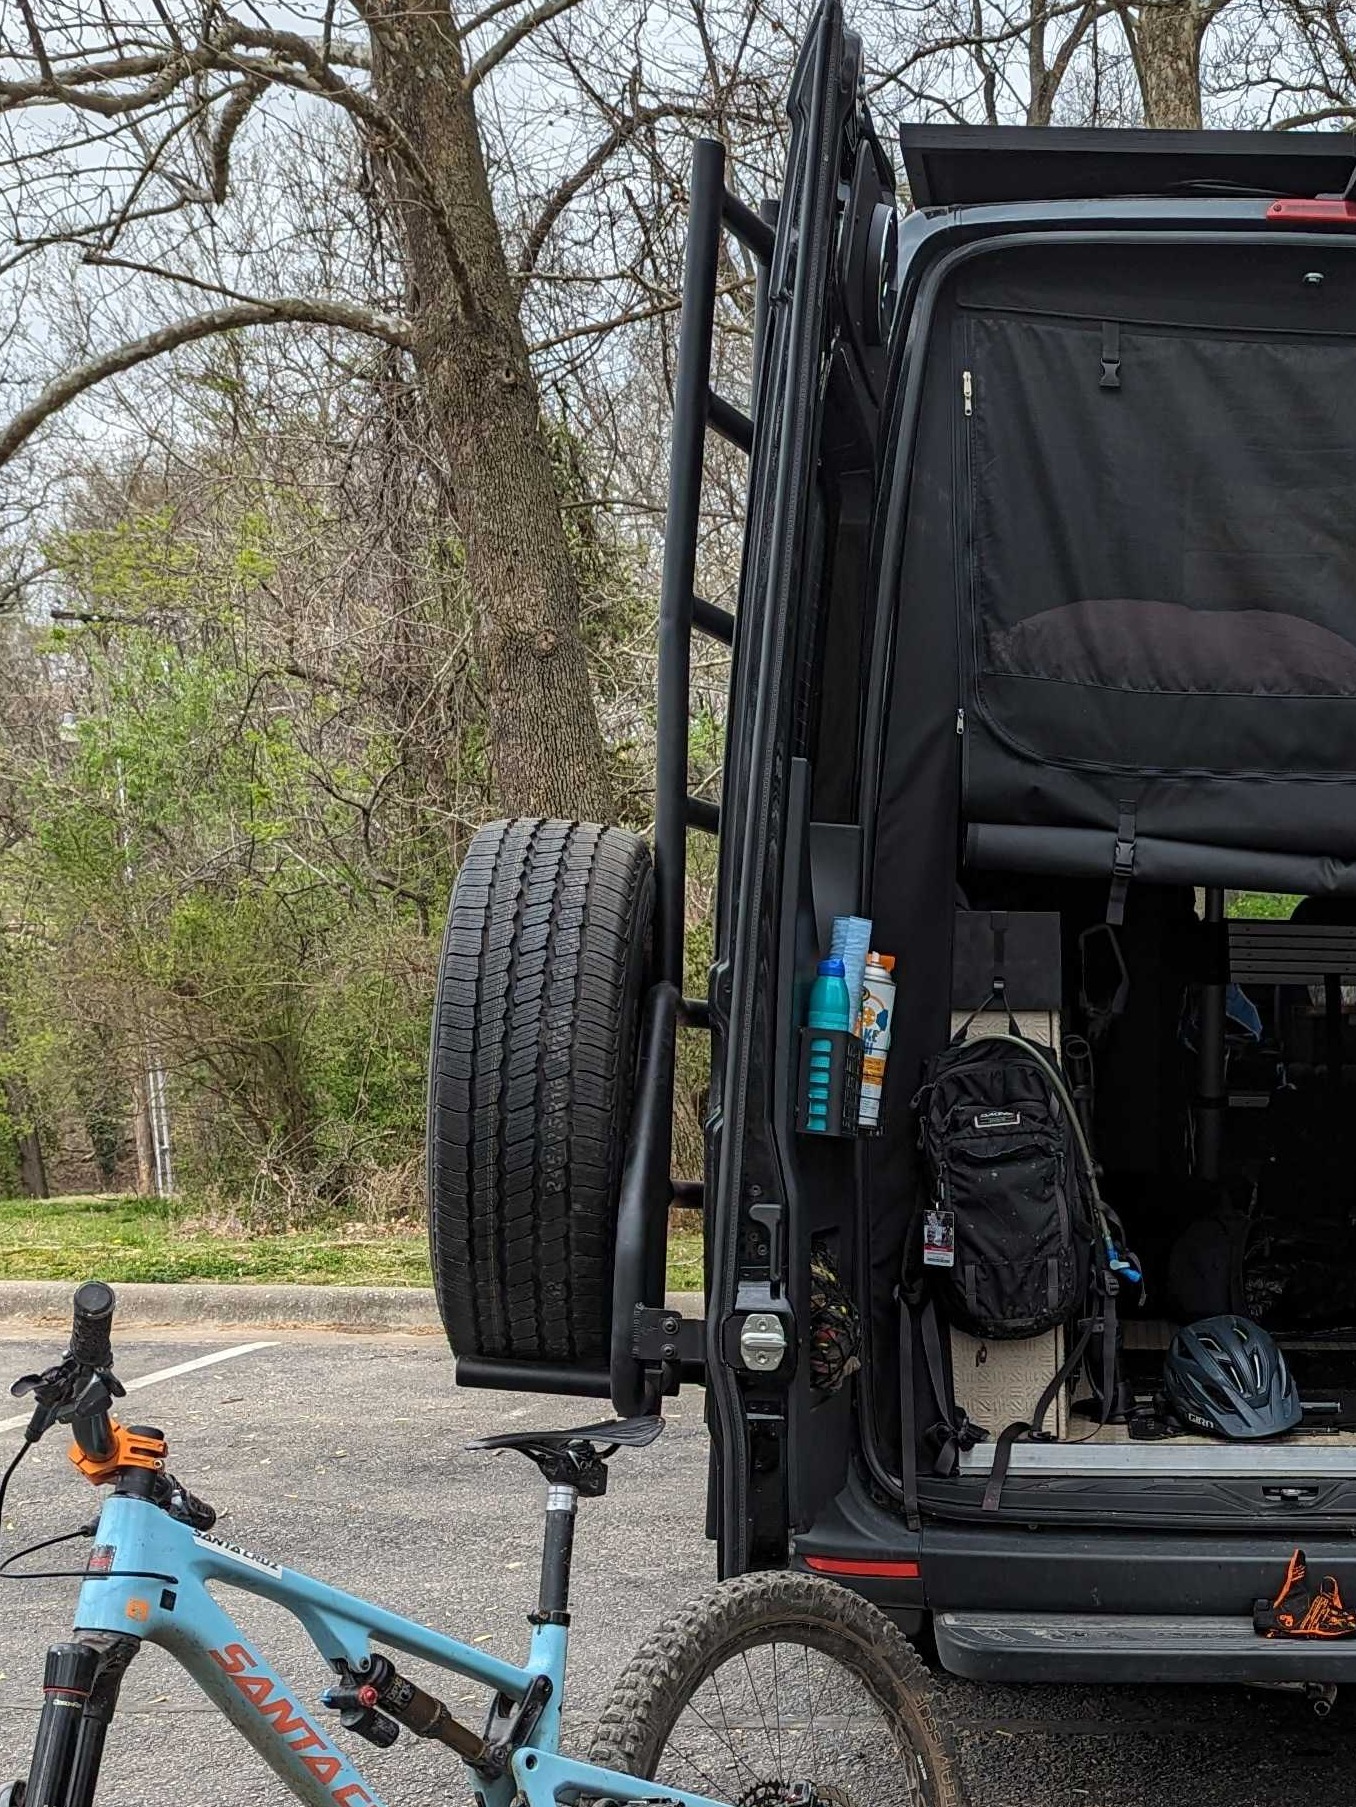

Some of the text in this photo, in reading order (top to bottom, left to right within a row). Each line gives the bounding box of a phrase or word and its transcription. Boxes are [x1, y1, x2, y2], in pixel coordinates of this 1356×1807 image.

[192, 1528, 279, 1571] SANTA CRUZ
[208, 1643, 342, 1786] SANTA
